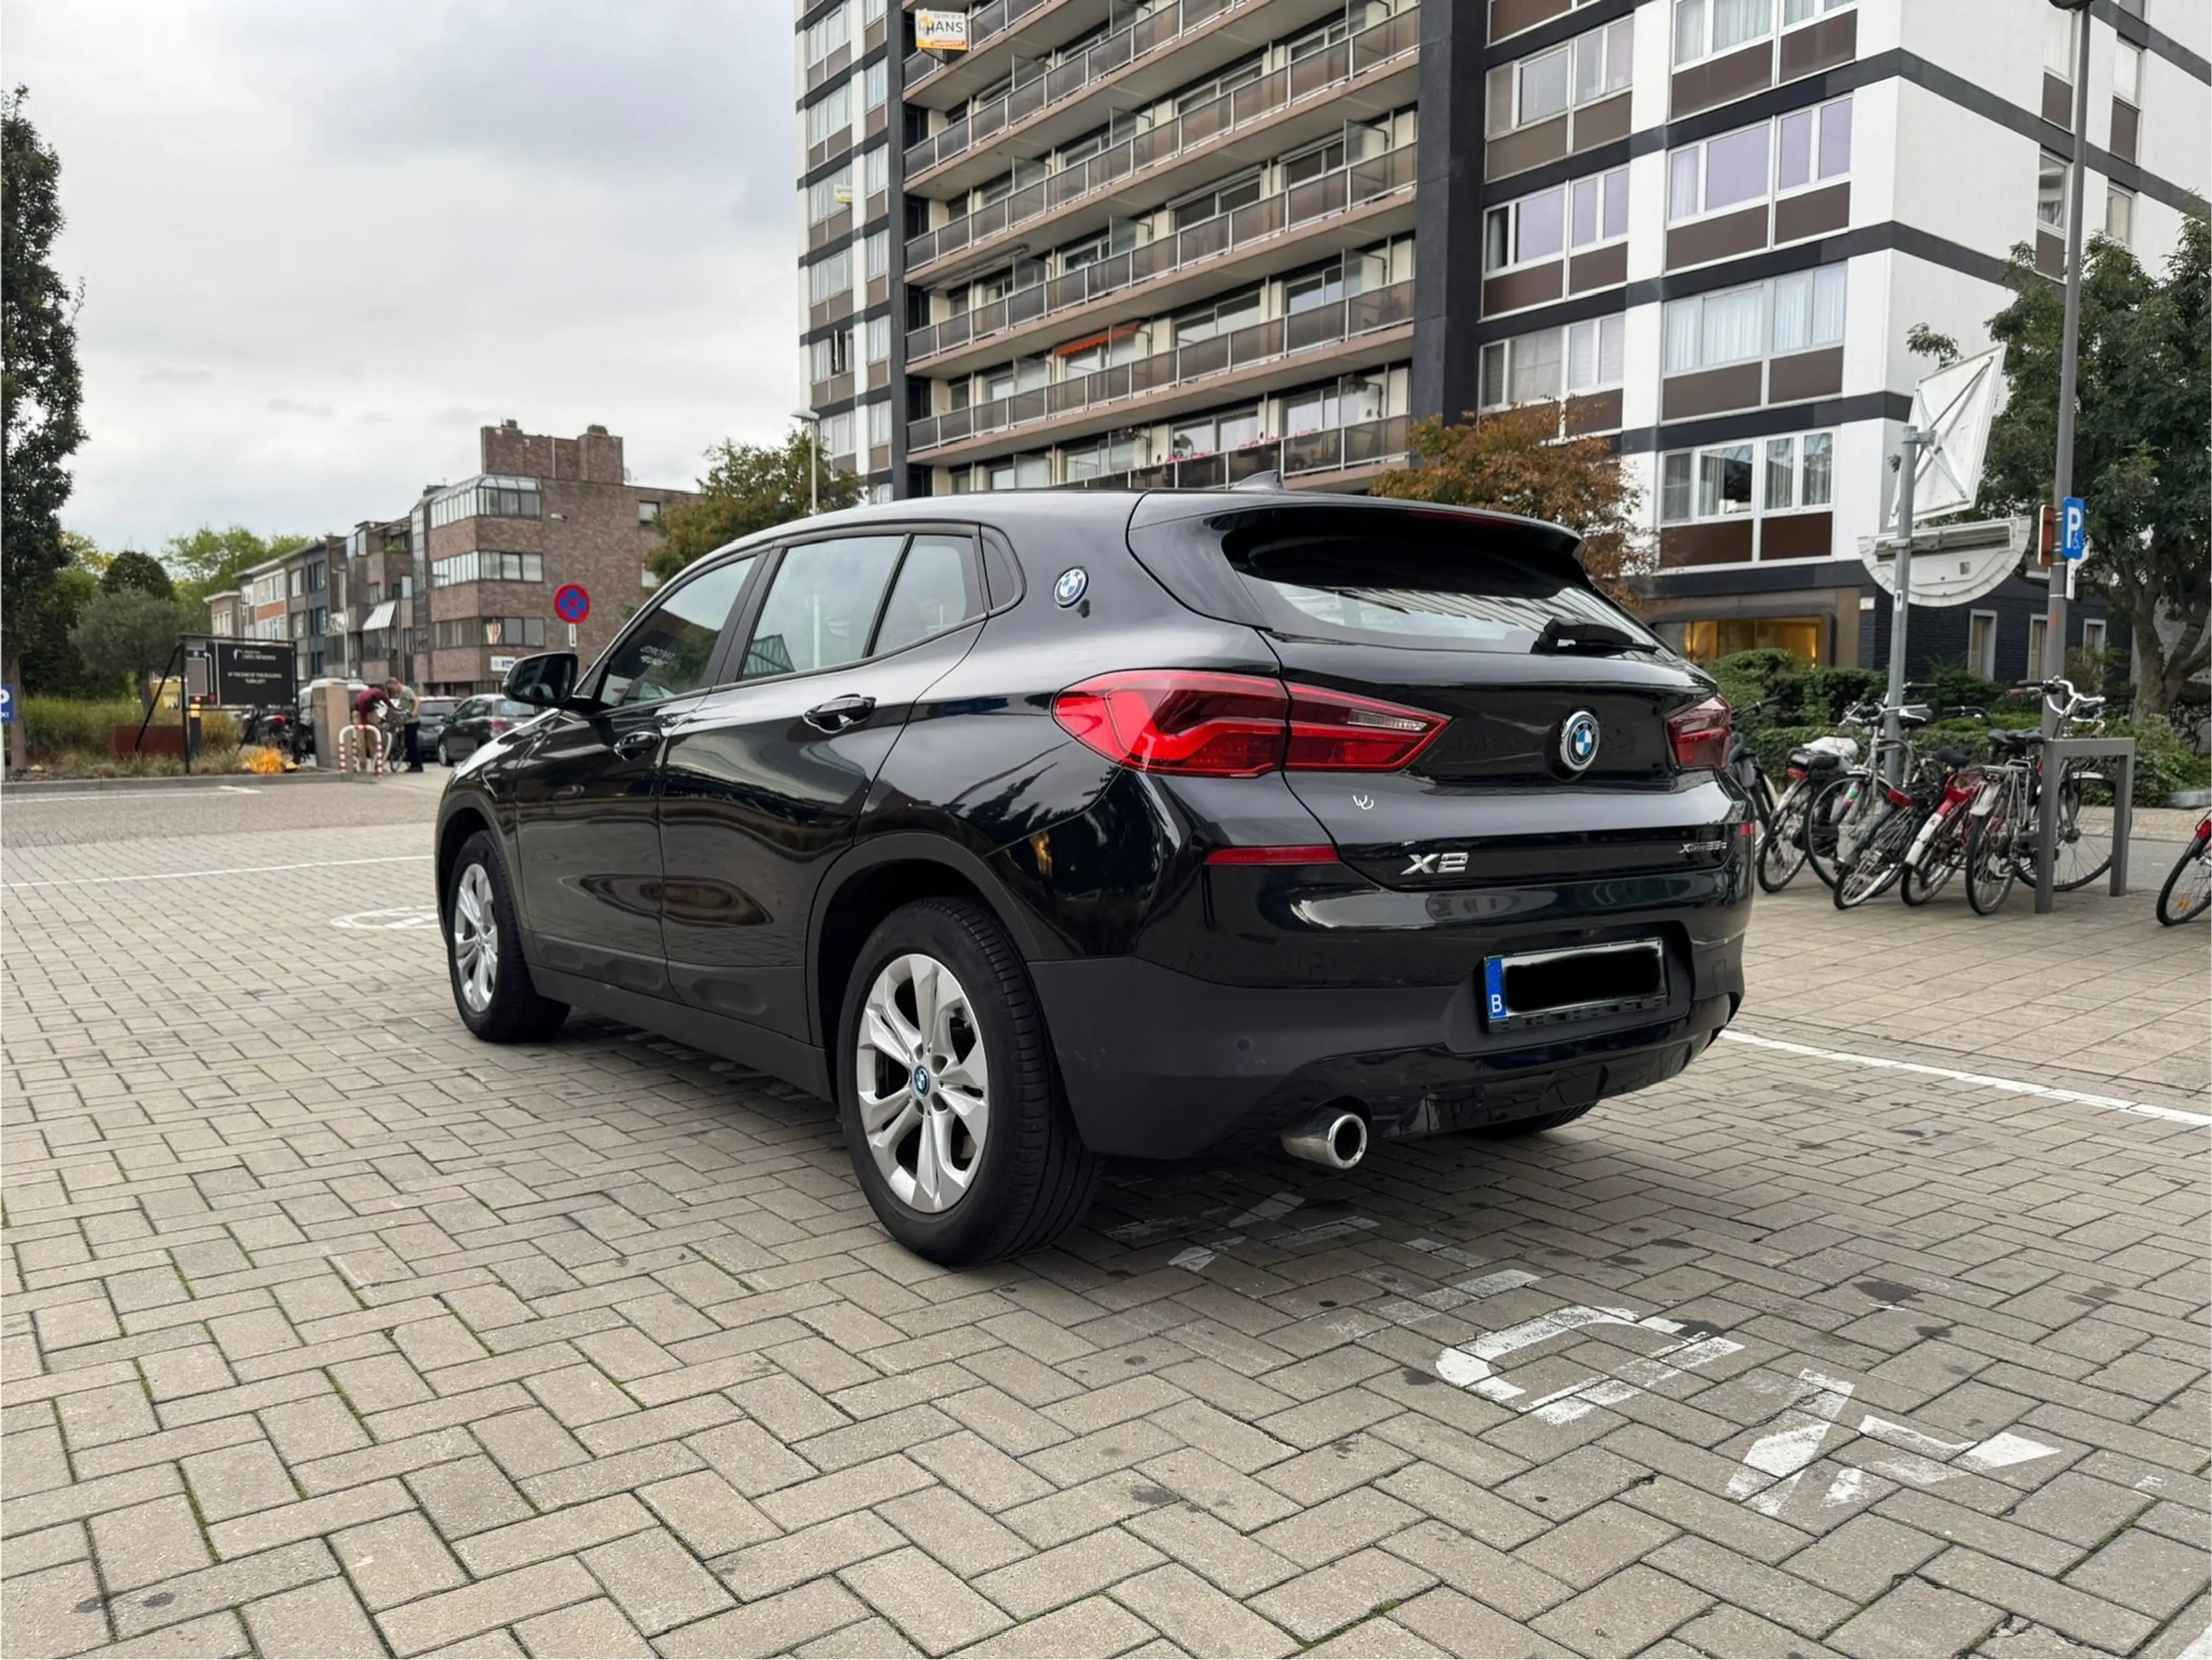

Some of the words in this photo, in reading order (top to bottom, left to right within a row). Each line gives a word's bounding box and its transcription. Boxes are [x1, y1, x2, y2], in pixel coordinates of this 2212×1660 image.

[926, 21, 963, 35] HANS
[2066, 507, 2081, 549] P
[1400, 852, 1469, 876] X2
[1491, 994, 1502, 1013] B
